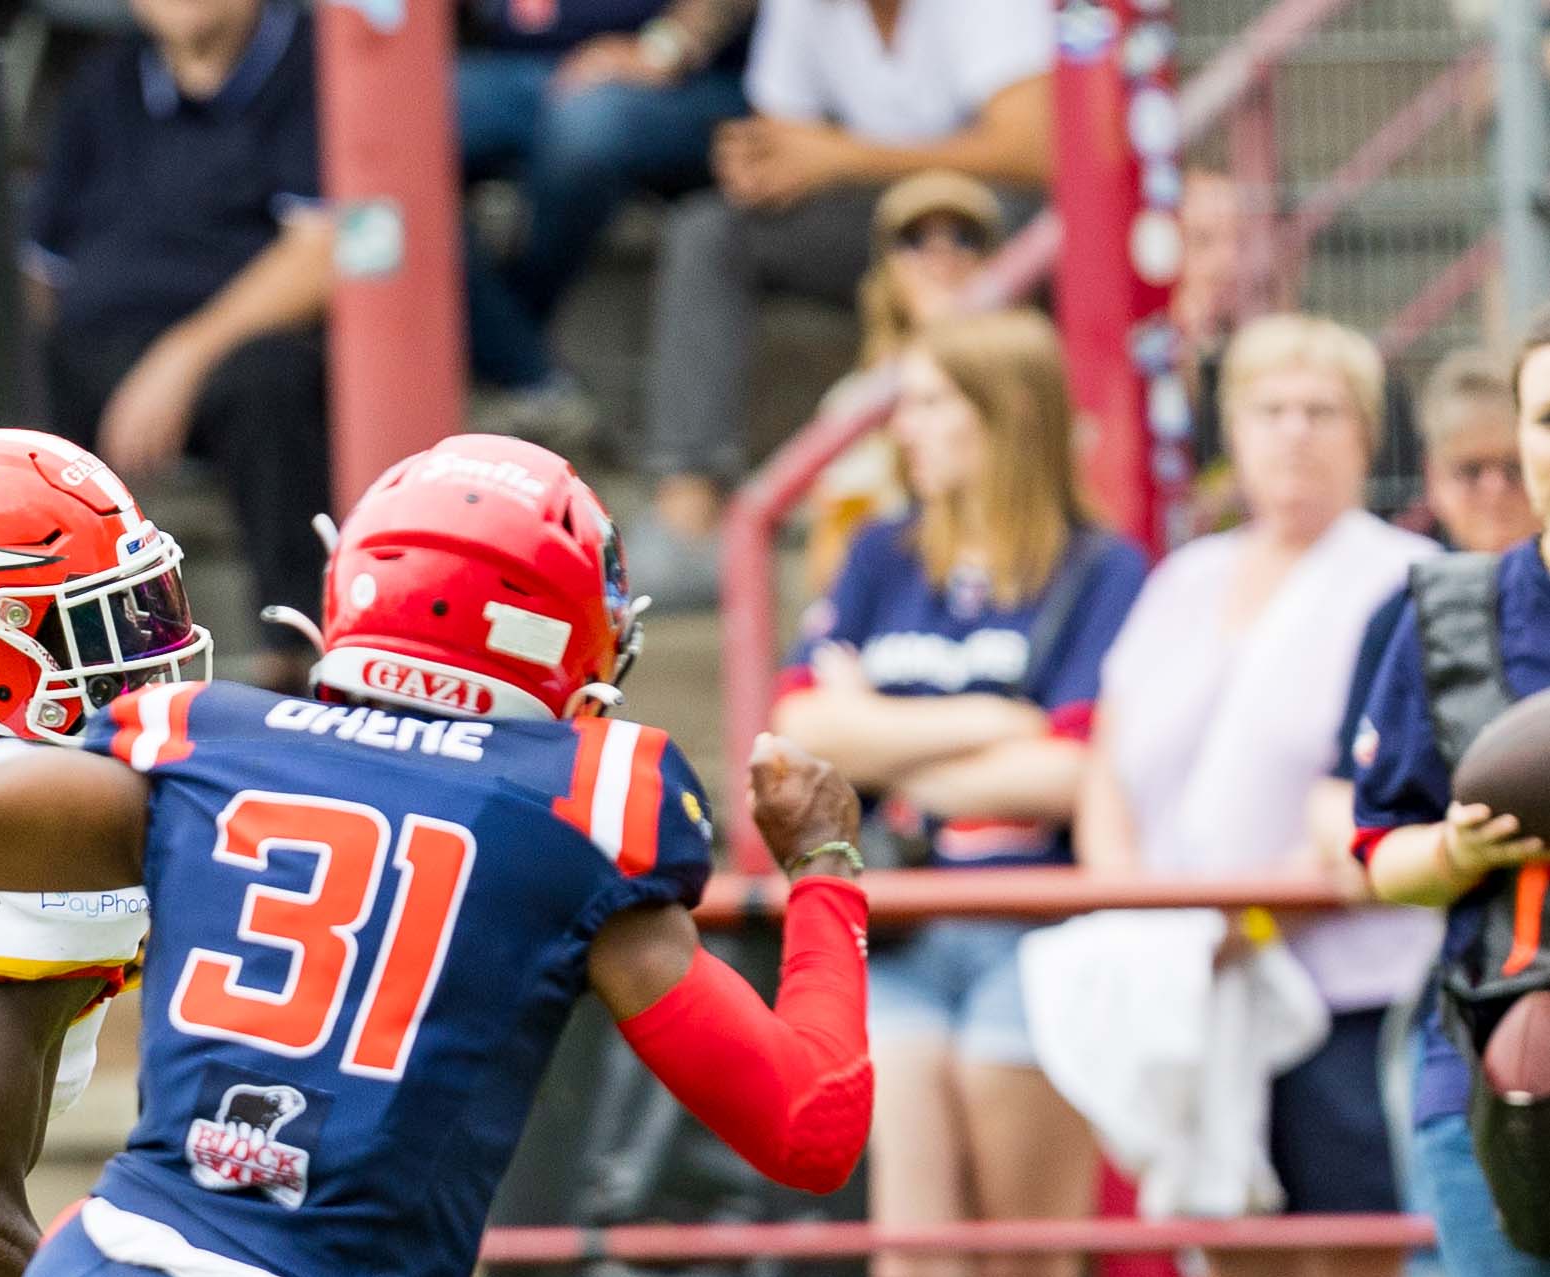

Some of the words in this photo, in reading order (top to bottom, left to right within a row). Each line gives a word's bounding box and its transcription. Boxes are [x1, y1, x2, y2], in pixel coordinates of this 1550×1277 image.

[368, 659, 487, 712] GAZI
[170, 789, 476, 1081] 31
[195, 1126, 299, 1175] BLOCK
